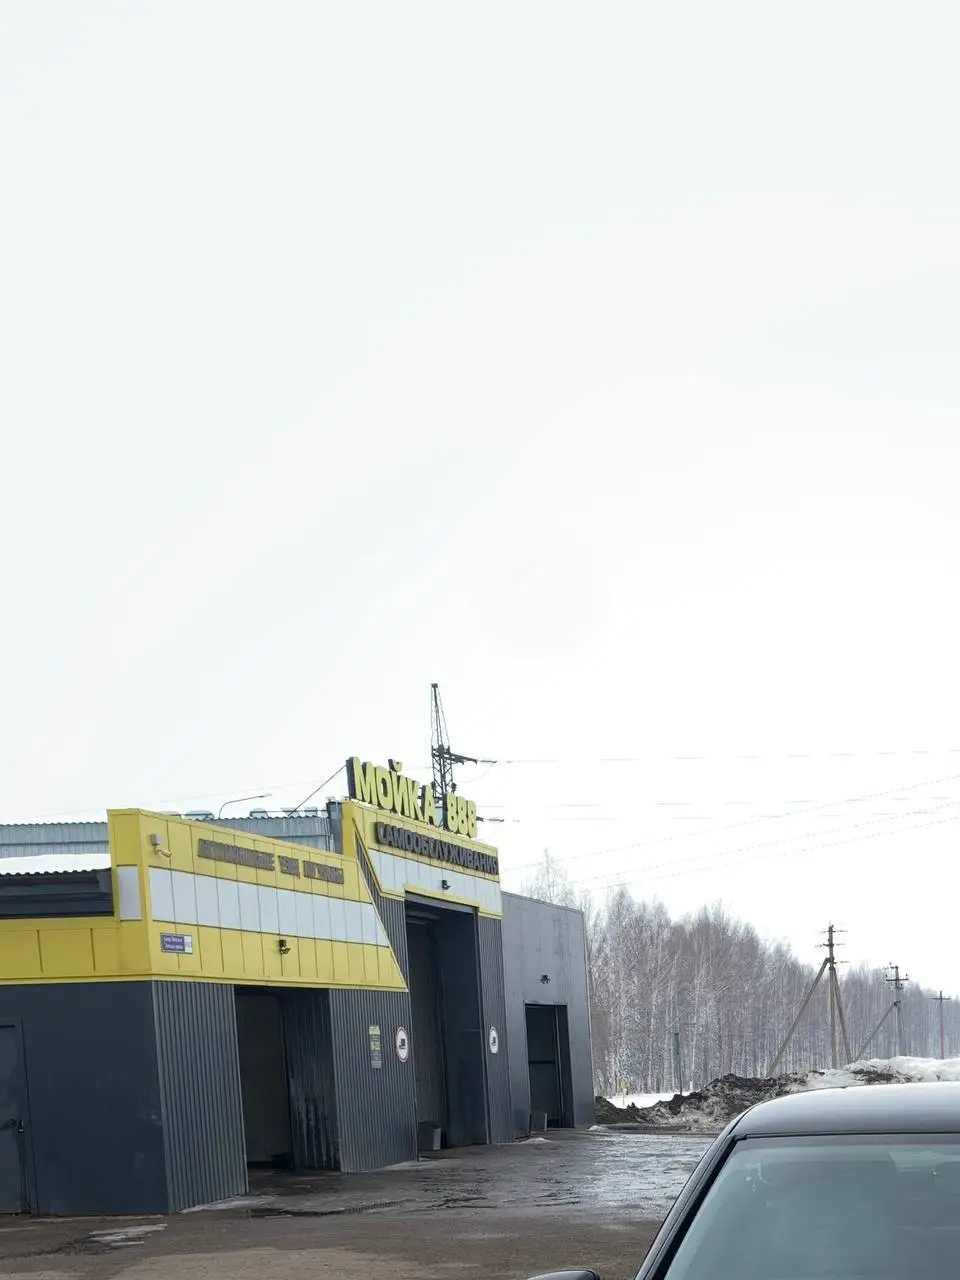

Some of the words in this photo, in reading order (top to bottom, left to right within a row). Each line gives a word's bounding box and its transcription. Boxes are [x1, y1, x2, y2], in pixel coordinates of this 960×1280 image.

[347, 757, 438, 828] МОЙКА
[443, 792, 477, 838] 888
[375, 822, 500, 875] САМООБСЛУЖИВАНИЯ
